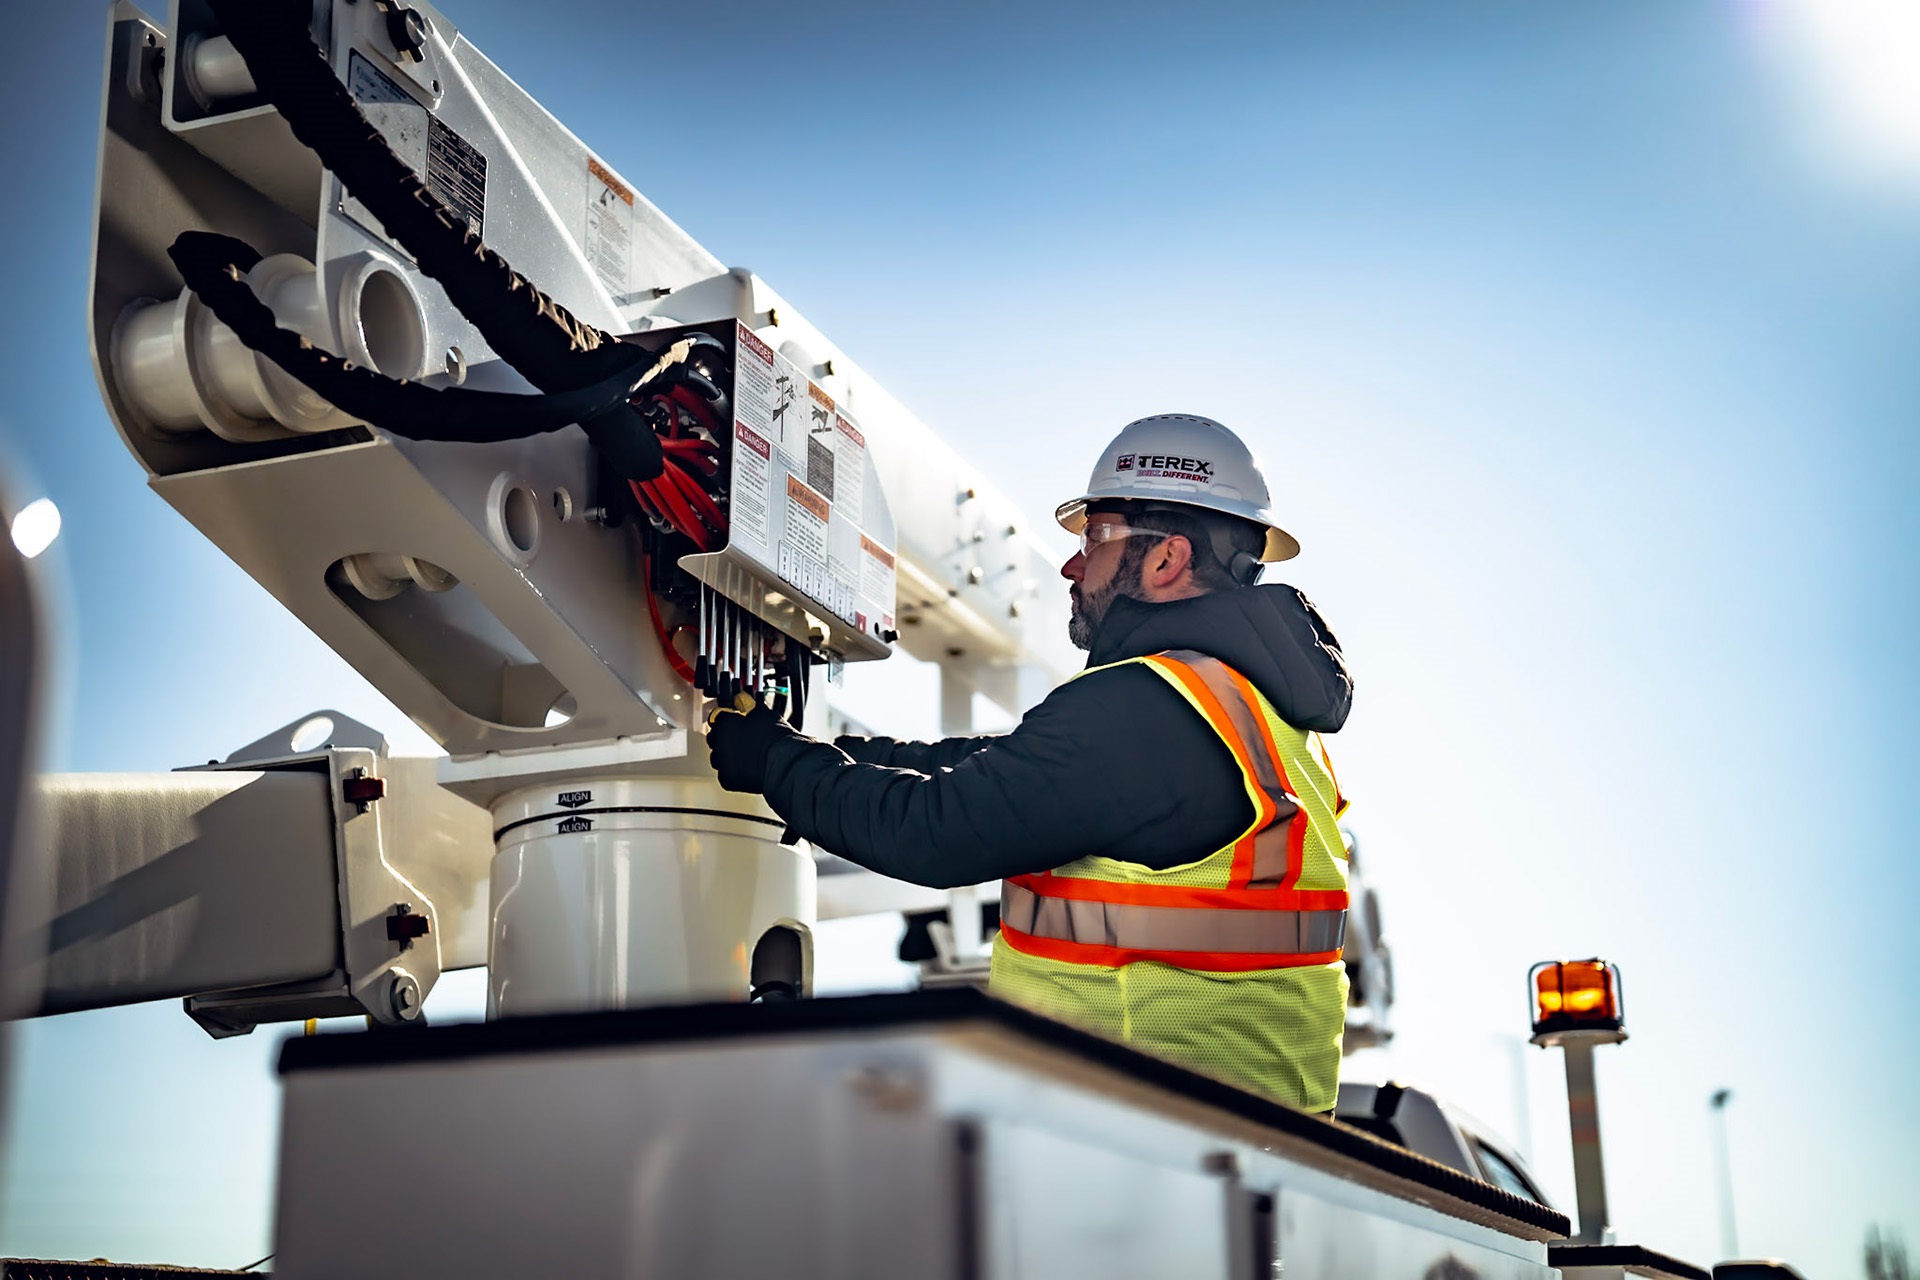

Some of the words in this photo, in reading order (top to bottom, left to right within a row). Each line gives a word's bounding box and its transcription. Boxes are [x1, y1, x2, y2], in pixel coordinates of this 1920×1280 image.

[745, 331, 772, 363] DANGER
[744, 430, 769, 455] DANGER
[1162, 470, 1209, 483] DIFFERENT.
[560, 792, 588, 803] ALIGN
[560, 822, 588, 832] ALIGN
